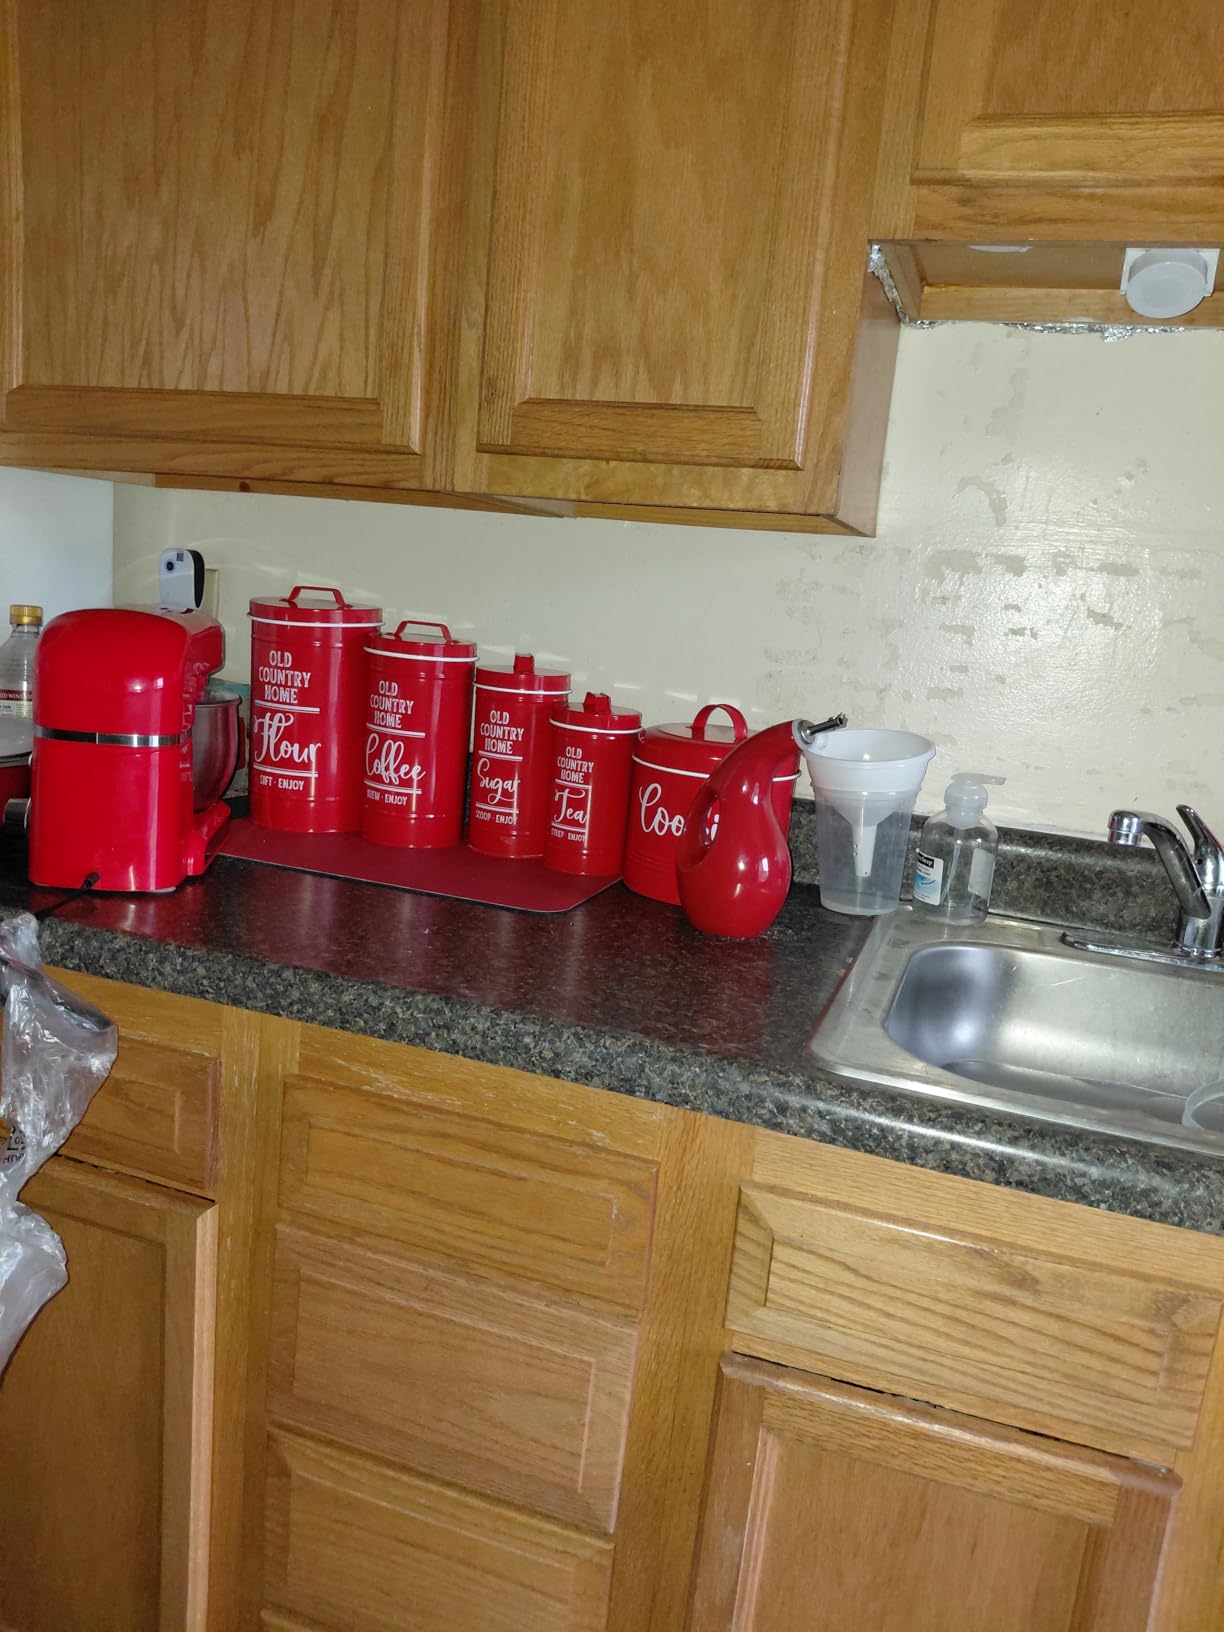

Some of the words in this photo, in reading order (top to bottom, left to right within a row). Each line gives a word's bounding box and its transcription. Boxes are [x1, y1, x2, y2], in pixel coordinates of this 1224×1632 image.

[269, 650, 293, 668] OLD
[259, 666, 312, 688] COUNTRY
[264, 684, 299, 704] HOME
[379, 680, 398, 697] OLD
[370, 694, 414, 715] COUNTRY
[374, 710, 402, 729] HOME
[489, 709, 510, 725] OLD
[253, 712, 322, 763] Flour
[480, 722, 525, 742] COUNTRY
[484, 738, 514, 754] HOME
[565, 746, 583, 759] OLD
[365, 733, 426, 785] Coffee
[557, 756, 595, 773] COUNTRY
[278, 778, 305, 791] ENJOY
[477, 758, 521, 804] Sugar
[560, 768, 585, 784] HOME
[384, 793, 408, 806] ENJOY
[553, 788, 588, 824] Tea
[496, 814, 518, 826] ENJOY
